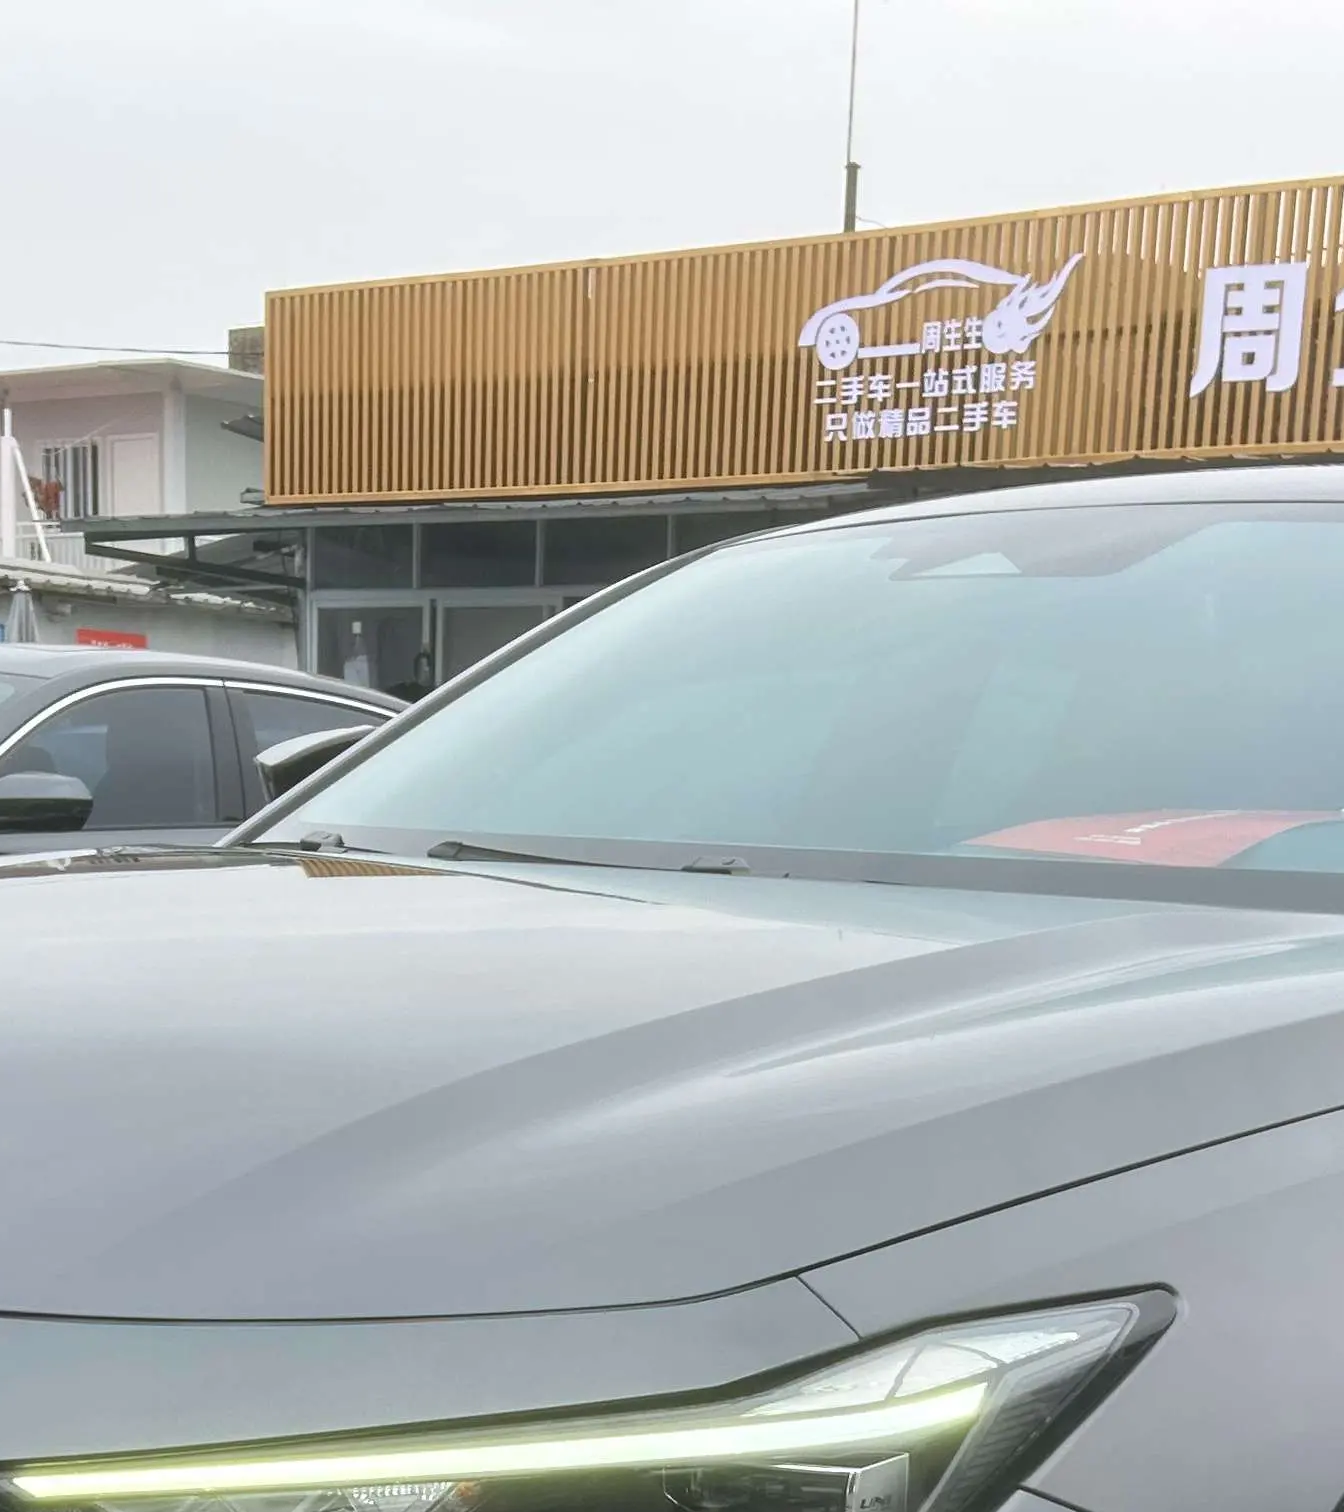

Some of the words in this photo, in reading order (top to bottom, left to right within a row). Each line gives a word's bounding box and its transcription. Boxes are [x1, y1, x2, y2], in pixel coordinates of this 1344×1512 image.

[922, 316, 983, 353] 周生生
[814, 361, 1036, 404] 二手车一站式服务
[823, 400, 1018, 442] 只做精品二手车
